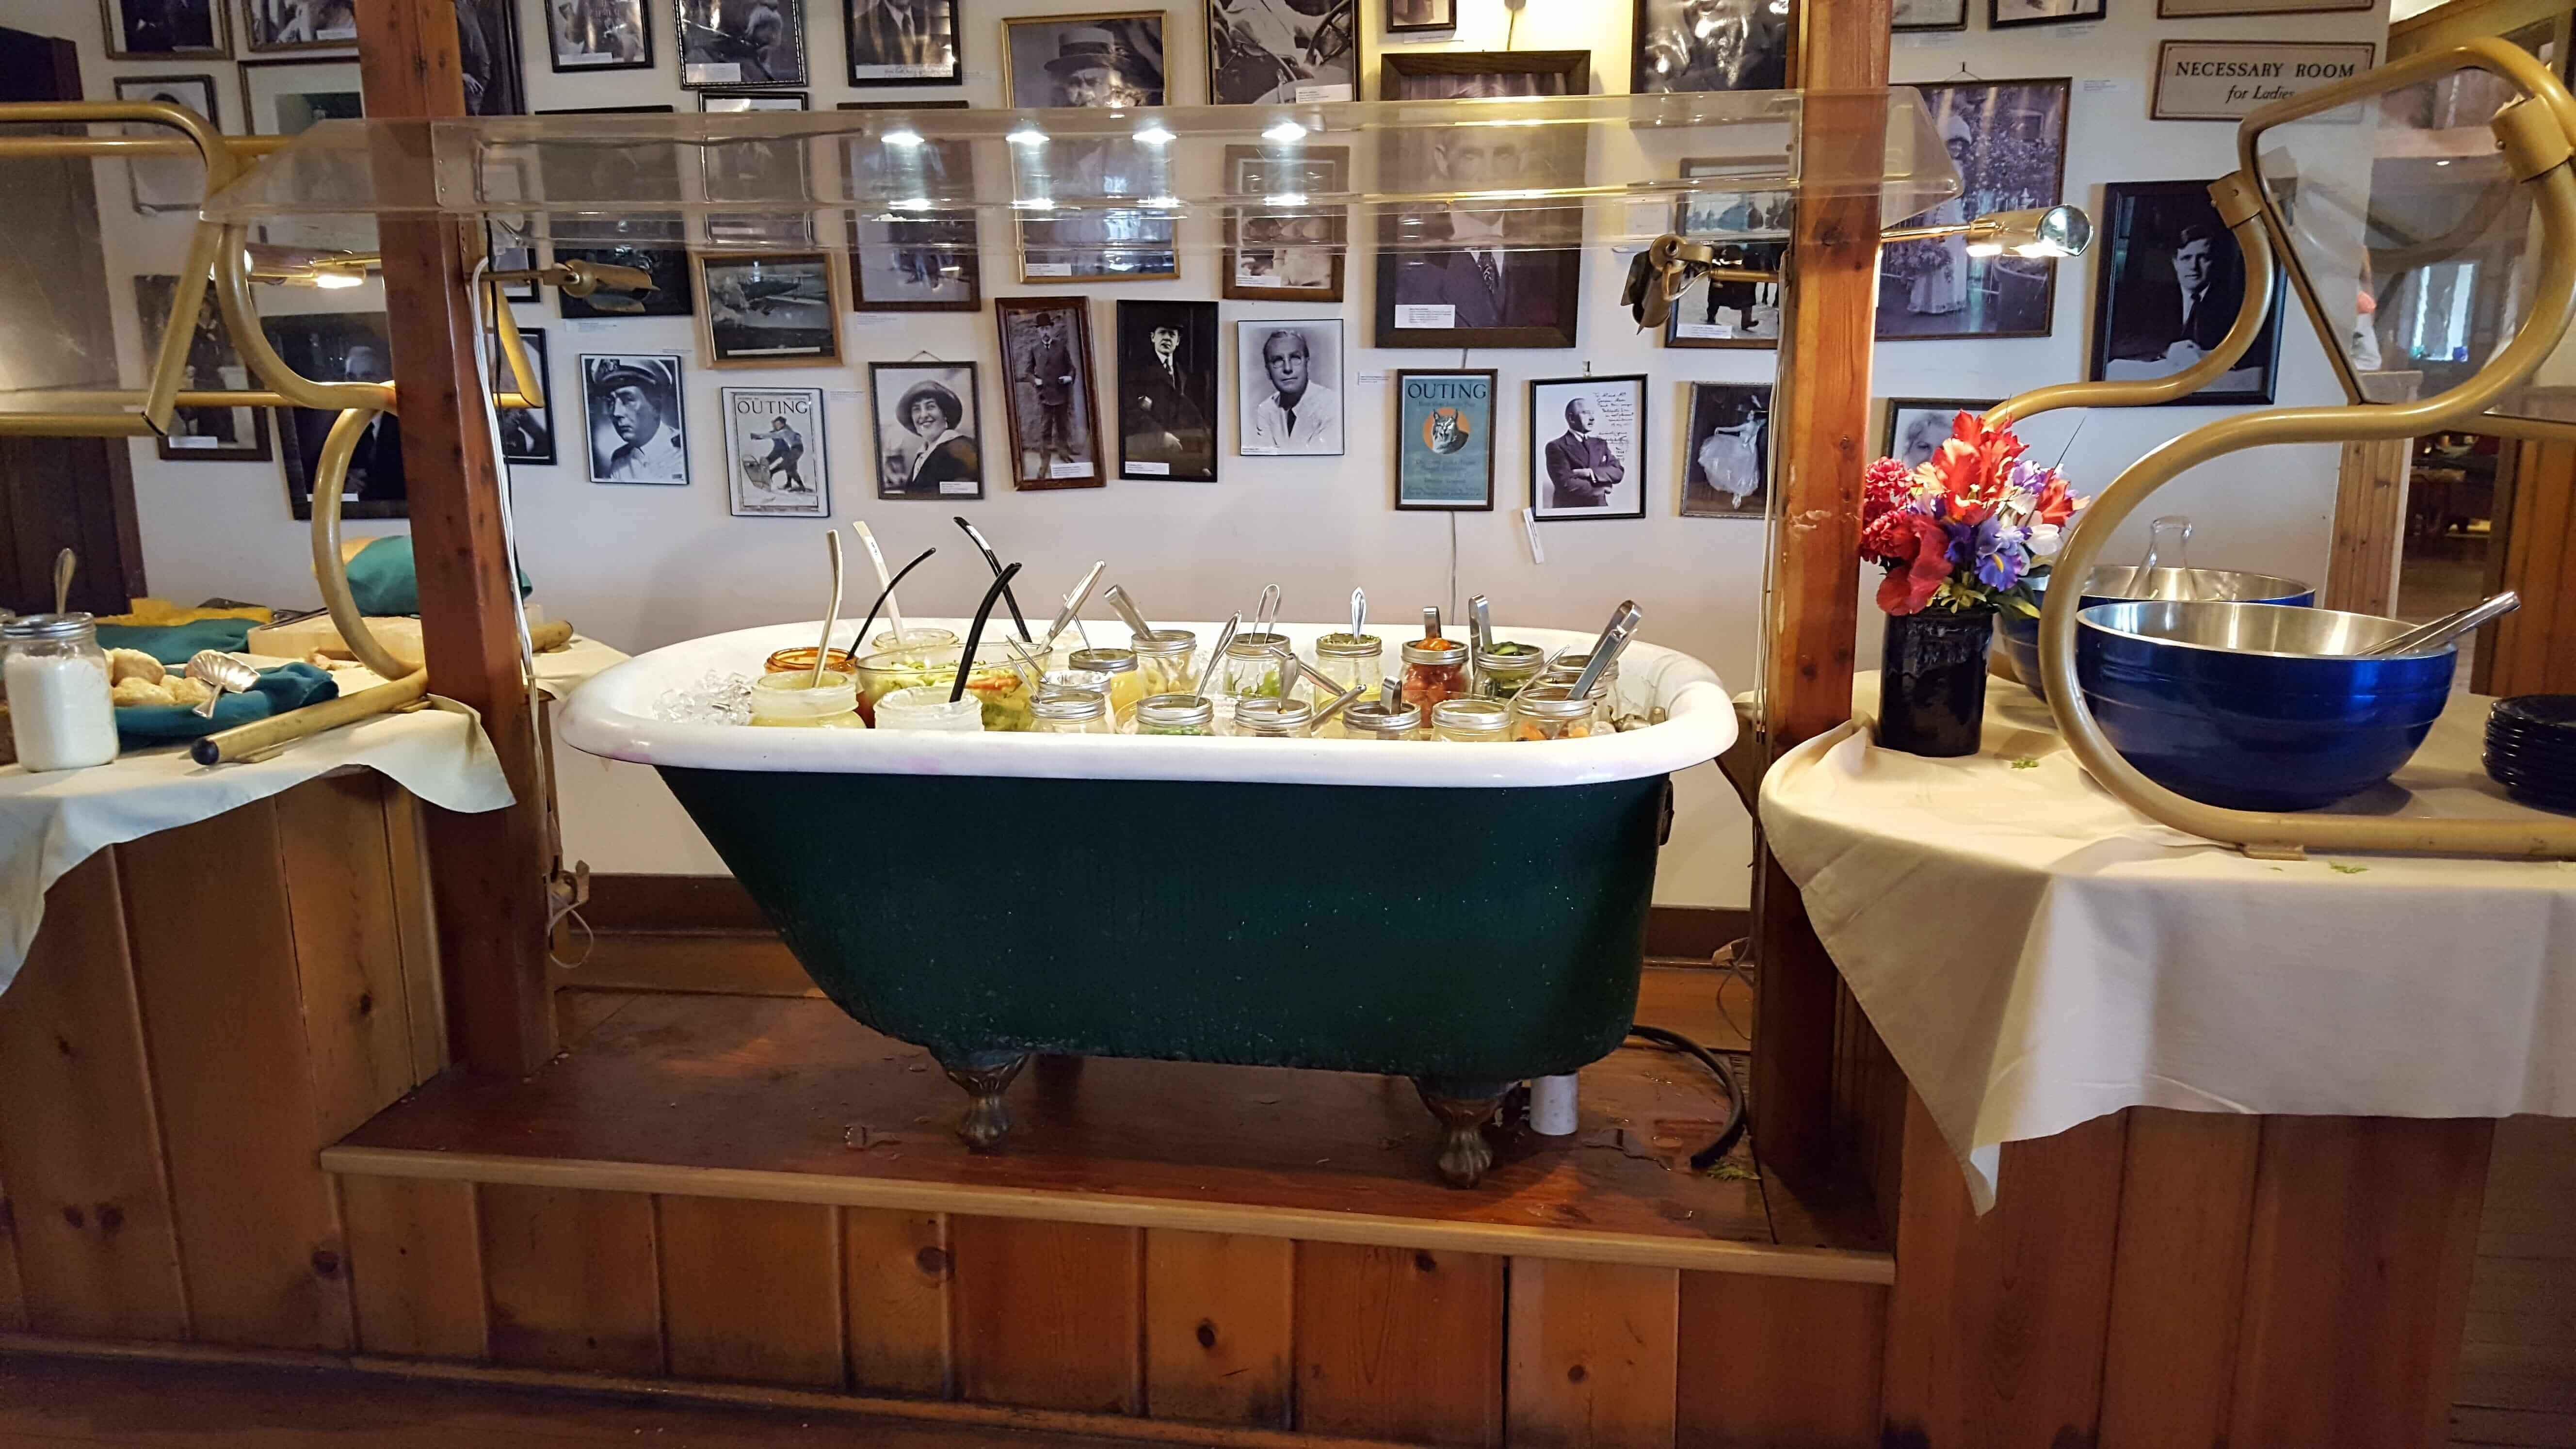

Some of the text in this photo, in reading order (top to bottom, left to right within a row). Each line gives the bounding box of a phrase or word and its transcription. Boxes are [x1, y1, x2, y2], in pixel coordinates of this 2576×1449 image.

[2175, 61, 2355, 78] NECESSARY ROOM
[2225, 84, 2249, 104] for
[1407, 383, 1486, 399] OUTING
[737, 400, 808, 414] OUTING
